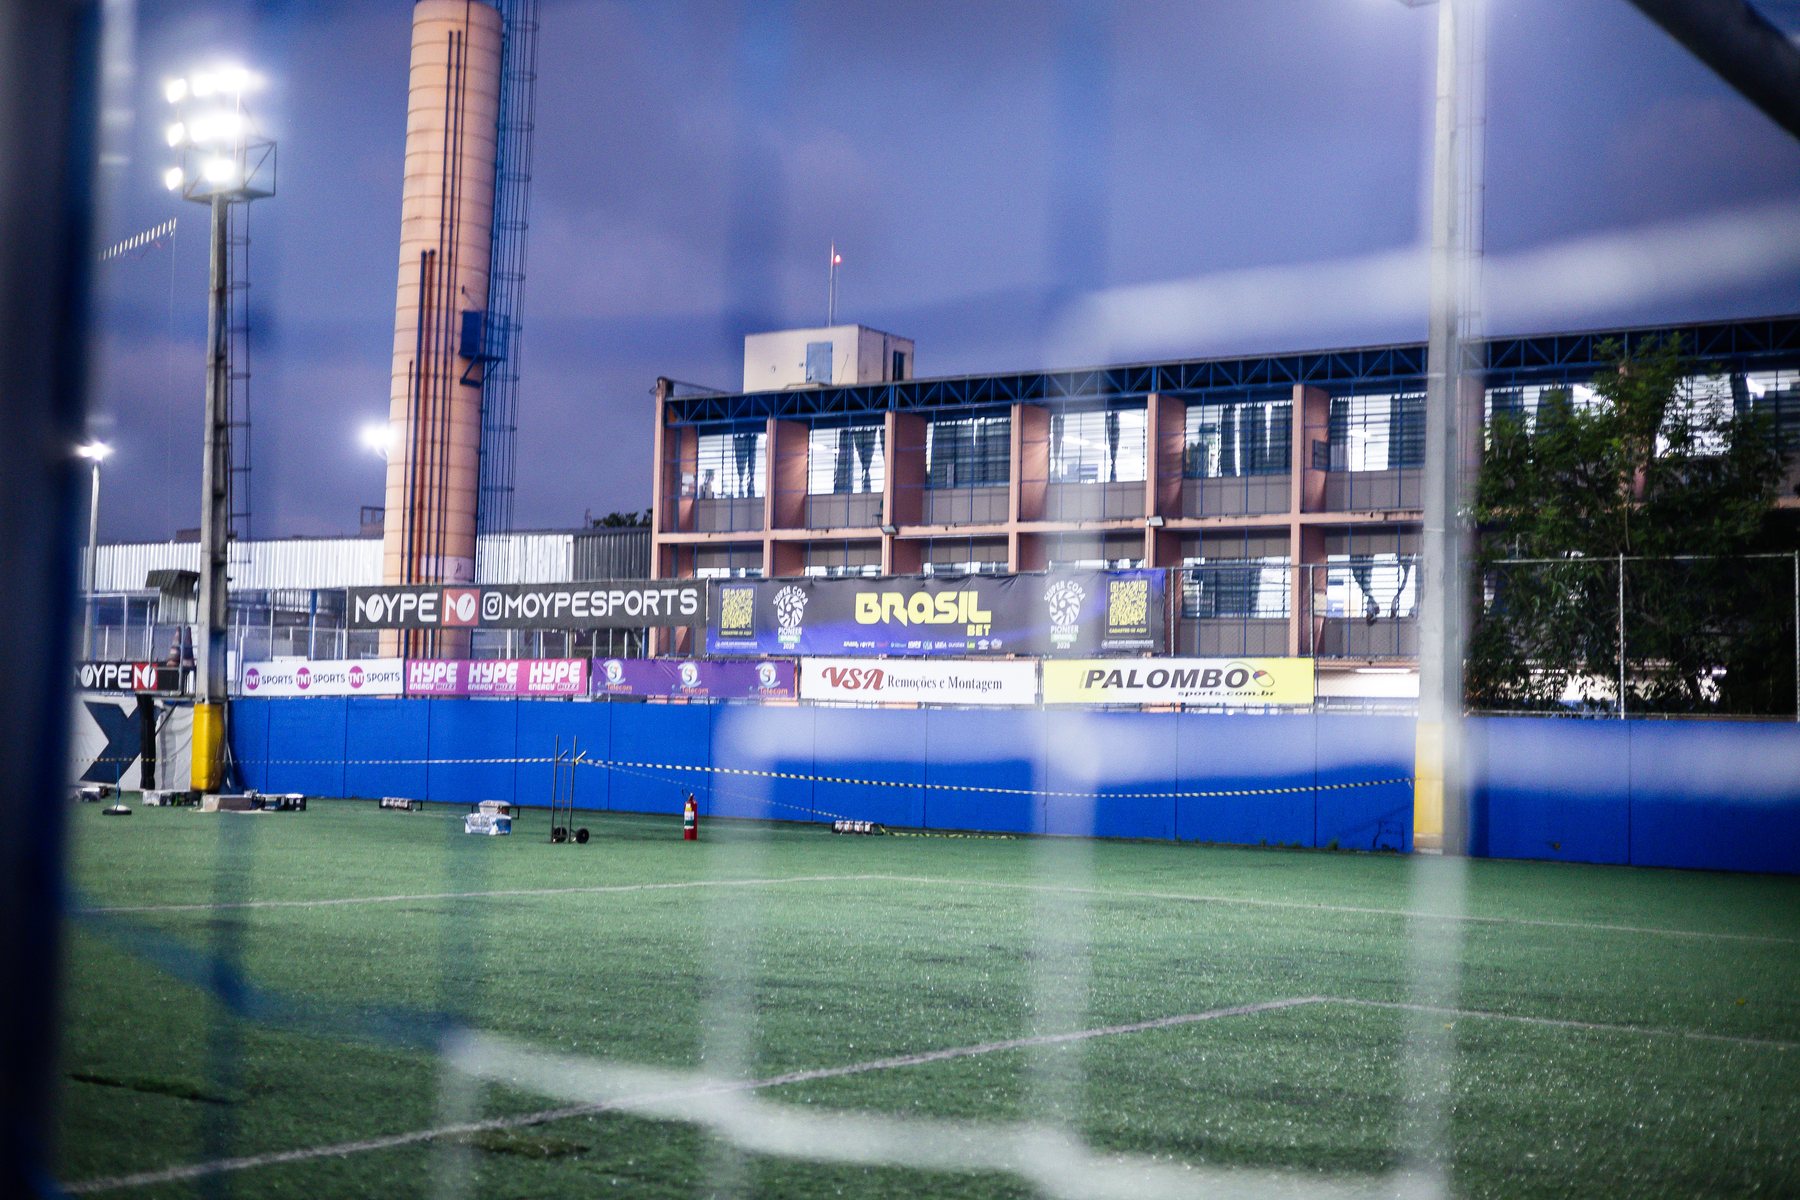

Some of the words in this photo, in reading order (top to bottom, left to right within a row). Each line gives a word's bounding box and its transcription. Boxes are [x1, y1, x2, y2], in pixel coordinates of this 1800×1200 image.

[504, 588, 698, 618] MOYPESPORTS
[855, 591, 992, 627] BRASIL
[966, 624, 991, 637] BET
[366, 672, 400, 683] SPORTS
[409, 662, 458, 683] HYPE
[468, 662, 519, 683] HYPE
[529, 661, 582, 683] HYPE
[262, 675, 293, 685] SPORTS
[313, 673, 346, 684] SPORTS
[887, 675, 937, 691] Remoções
[939, 680, 945, 688] e
[948, 676, 1003, 692] Montagem
[1084, 668, 1250, 689] PALOMBO
[528, 683, 555, 691] ENERGY
[606, 683, 633, 692] Telecom
[681, 686, 709, 694] Telecom
[759, 686, 788, 695] Telecom
[1177, 689, 1276, 697] sports.com.br
